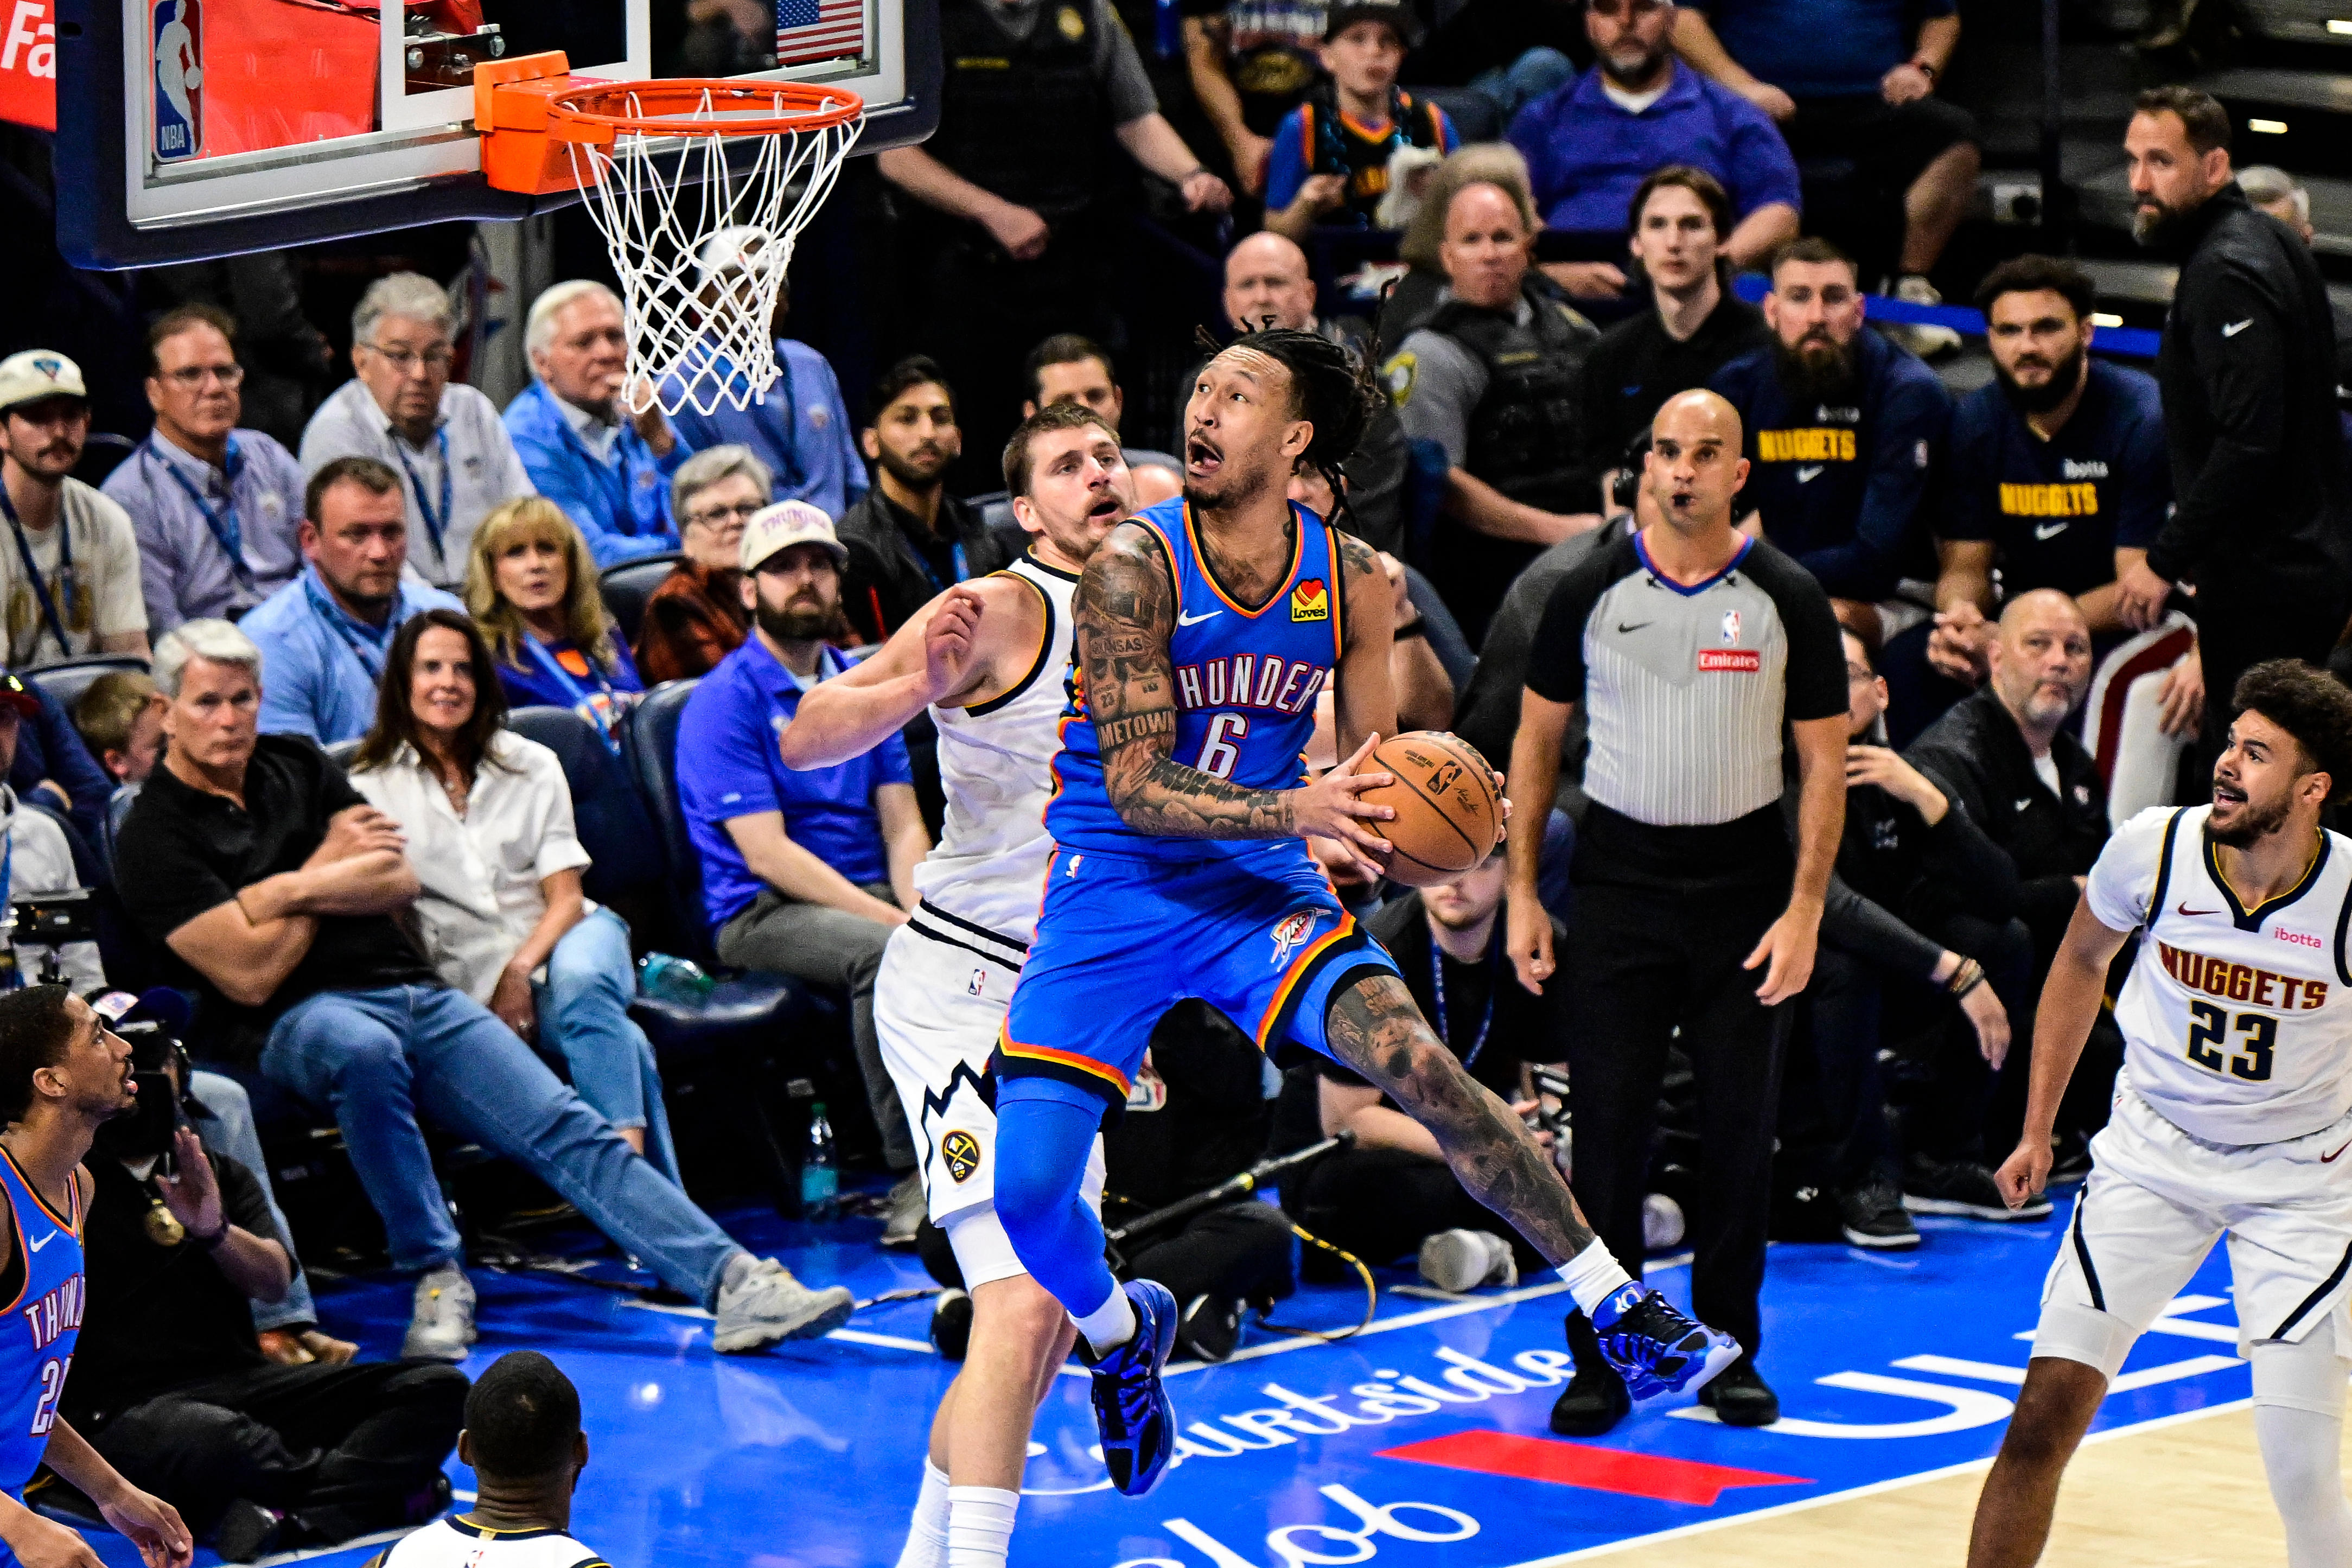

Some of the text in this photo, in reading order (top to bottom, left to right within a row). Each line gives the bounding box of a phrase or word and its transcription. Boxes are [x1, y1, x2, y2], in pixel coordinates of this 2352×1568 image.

[161, 123, 186, 151] NBA
[1175, 653, 1325, 715] HUNDER
[1196, 712, 1250, 779] 6
[2274, 927, 2322, 948] ibotta
[2158, 940, 2329, 1011] NUGGETS
[2187, 999, 2280, 1082] 23
